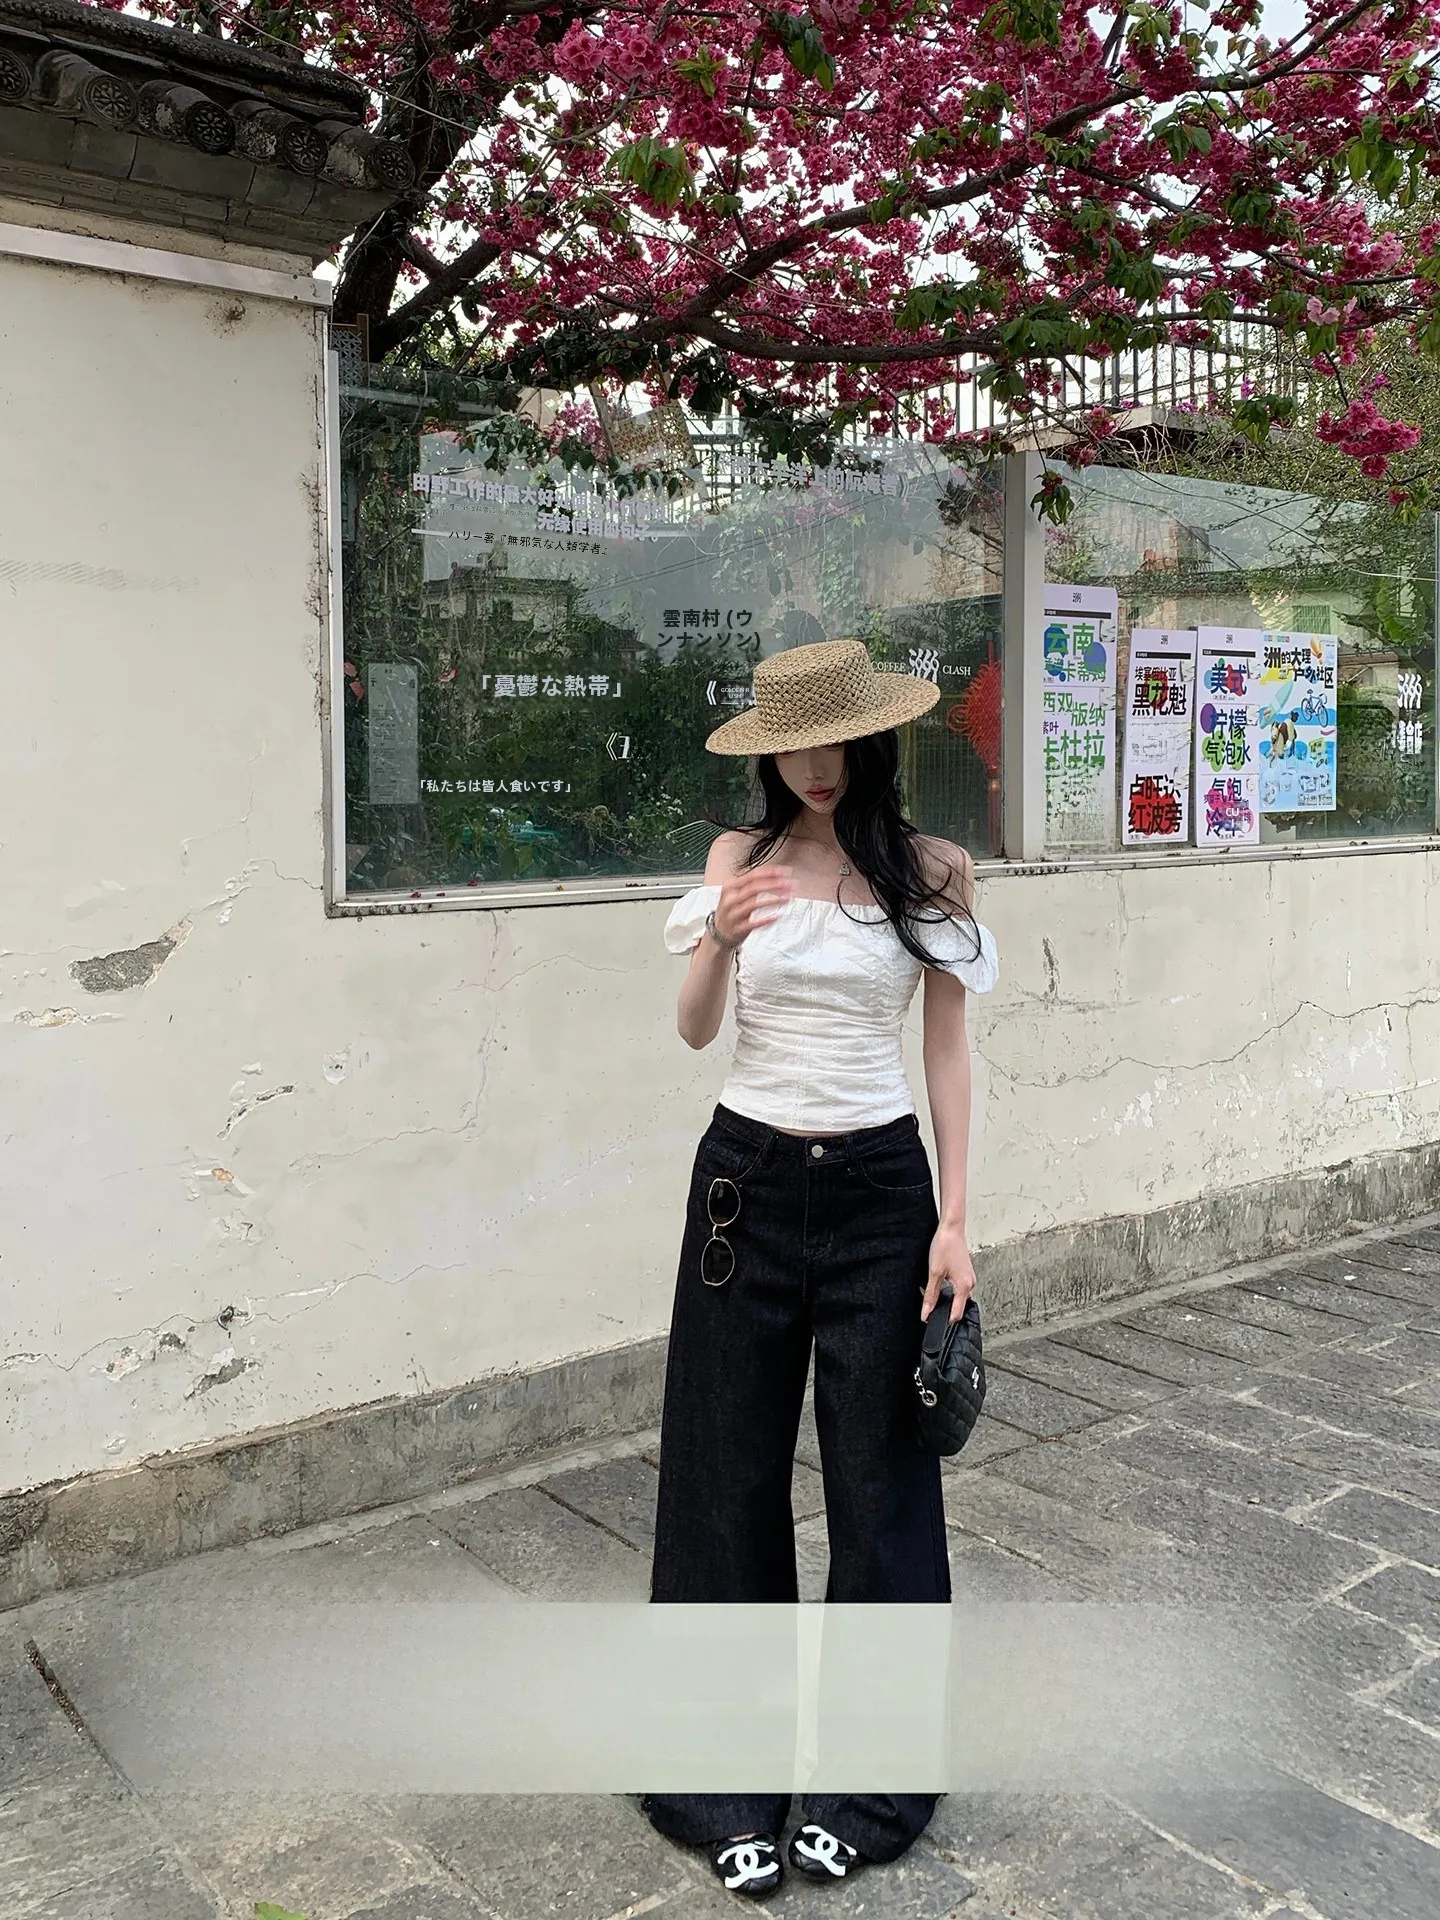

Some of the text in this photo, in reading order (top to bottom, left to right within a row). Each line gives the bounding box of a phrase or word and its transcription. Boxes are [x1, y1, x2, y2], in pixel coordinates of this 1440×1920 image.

[1264, 645, 1311, 669] 洲的大理
[942, 664, 972, 677] CLASH
[1210, 663, 1248, 696] 美式
[482, 674, 622, 698] 「憂鬱な熱帯」
[1132, 683, 1187, 717] 黑花魁
[1210, 708, 1248, 740] 柠檬
[1205, 740, 1252, 766] 气泡水
[420, 779, 572, 794] 「私たちは皆人食いです」
[1211, 777, 1243, 804] 气泡
